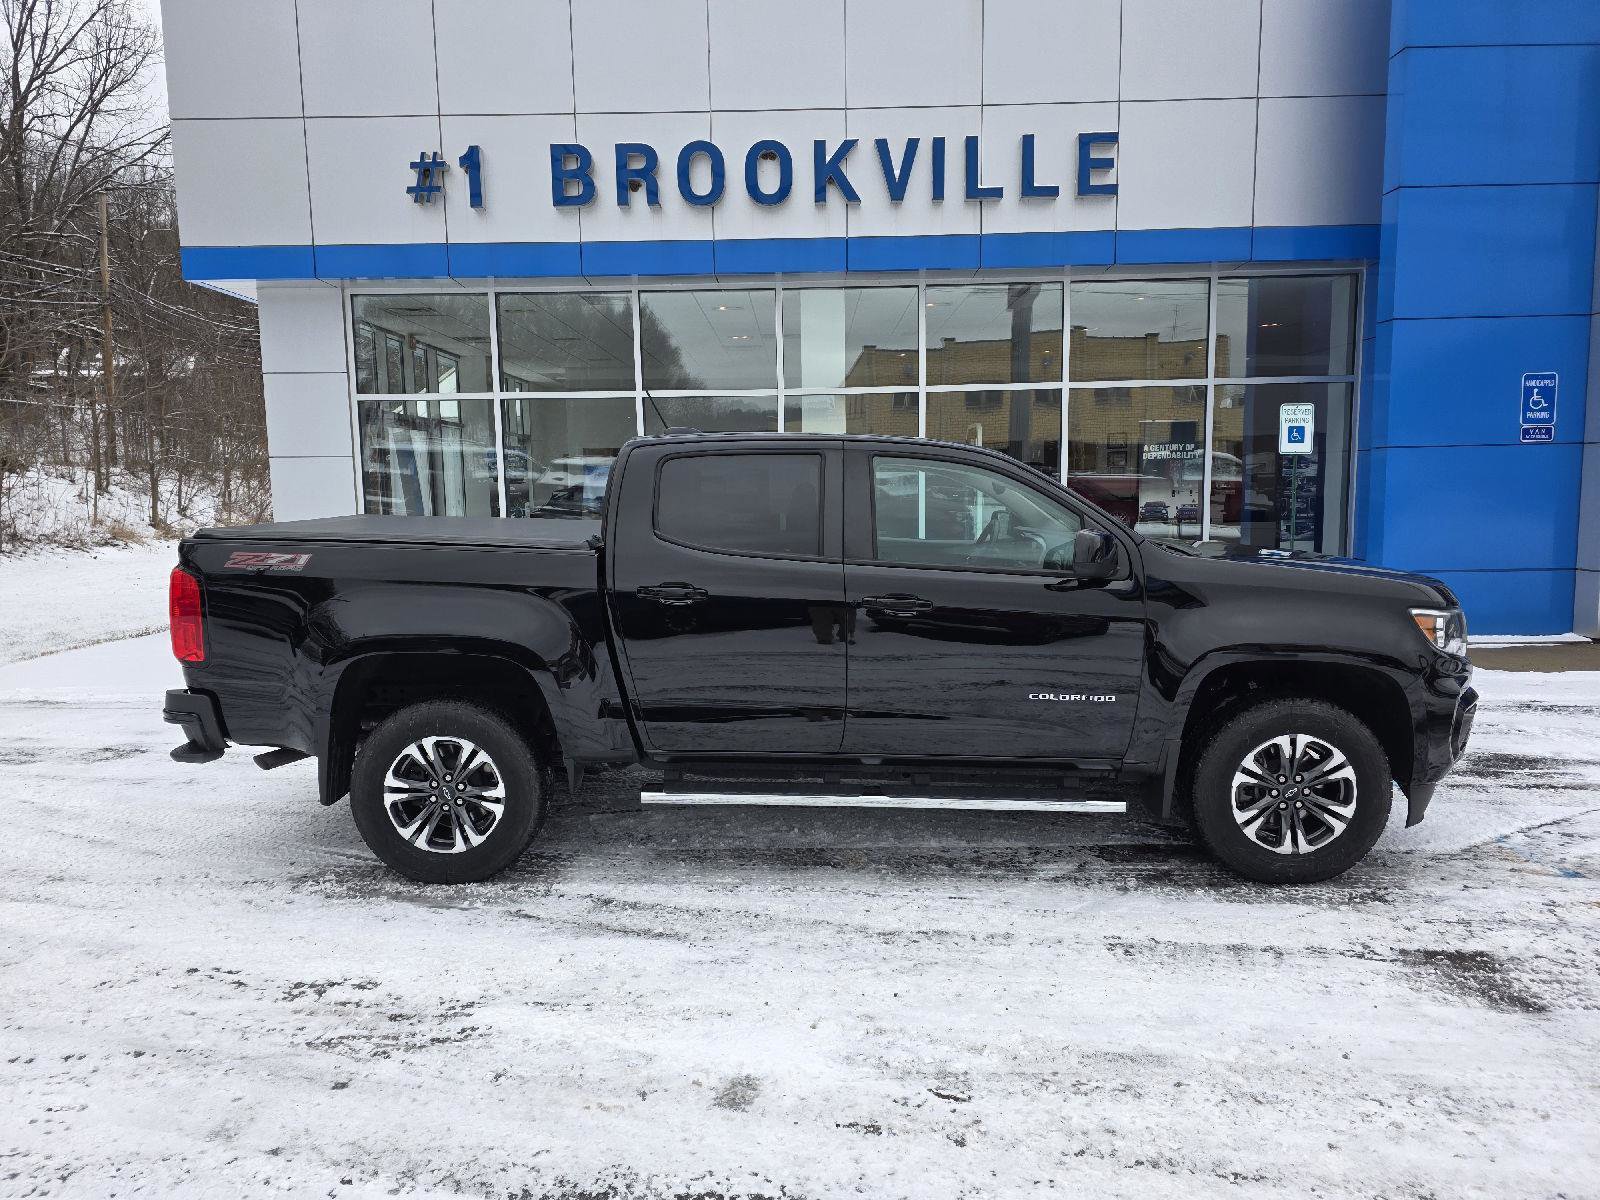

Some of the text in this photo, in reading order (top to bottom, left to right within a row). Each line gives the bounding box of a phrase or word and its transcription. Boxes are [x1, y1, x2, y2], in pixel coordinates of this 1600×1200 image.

[406, 132, 1119, 210] #1 BROOKVILLE
[1526, 411, 1550, 419] PARKING
[1143, 443, 1195, 452] A CENTURY OF
[1142, 450, 1201, 459] DEPENDABILITY
[223, 551, 313, 569] Z71
[1028, 693, 1116, 702] COLORADO
